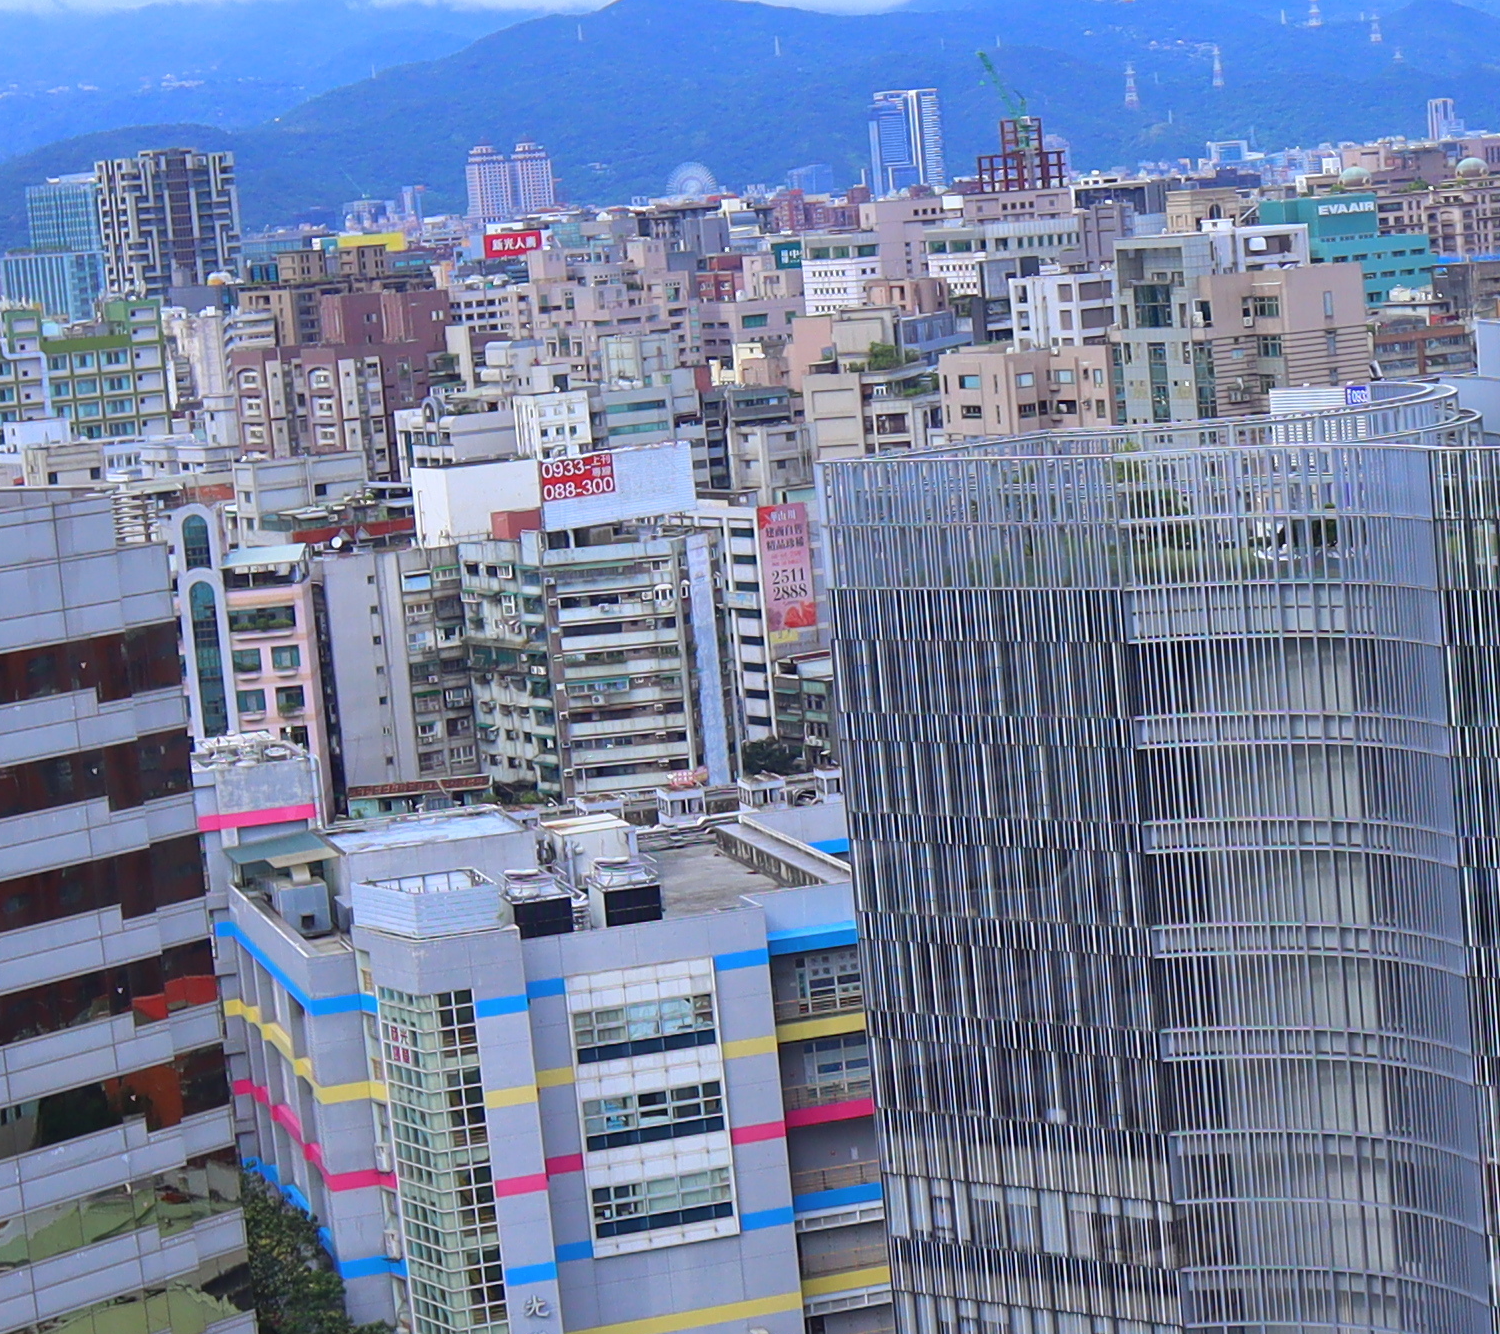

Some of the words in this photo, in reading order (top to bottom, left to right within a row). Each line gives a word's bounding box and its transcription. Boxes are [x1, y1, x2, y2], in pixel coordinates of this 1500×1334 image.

[491, 235, 537, 252] 新光人壽
[543, 476, 614, 501] 088-300
[771, 567, 805, 585] 2511
[773, 583, 808, 602] 2888
